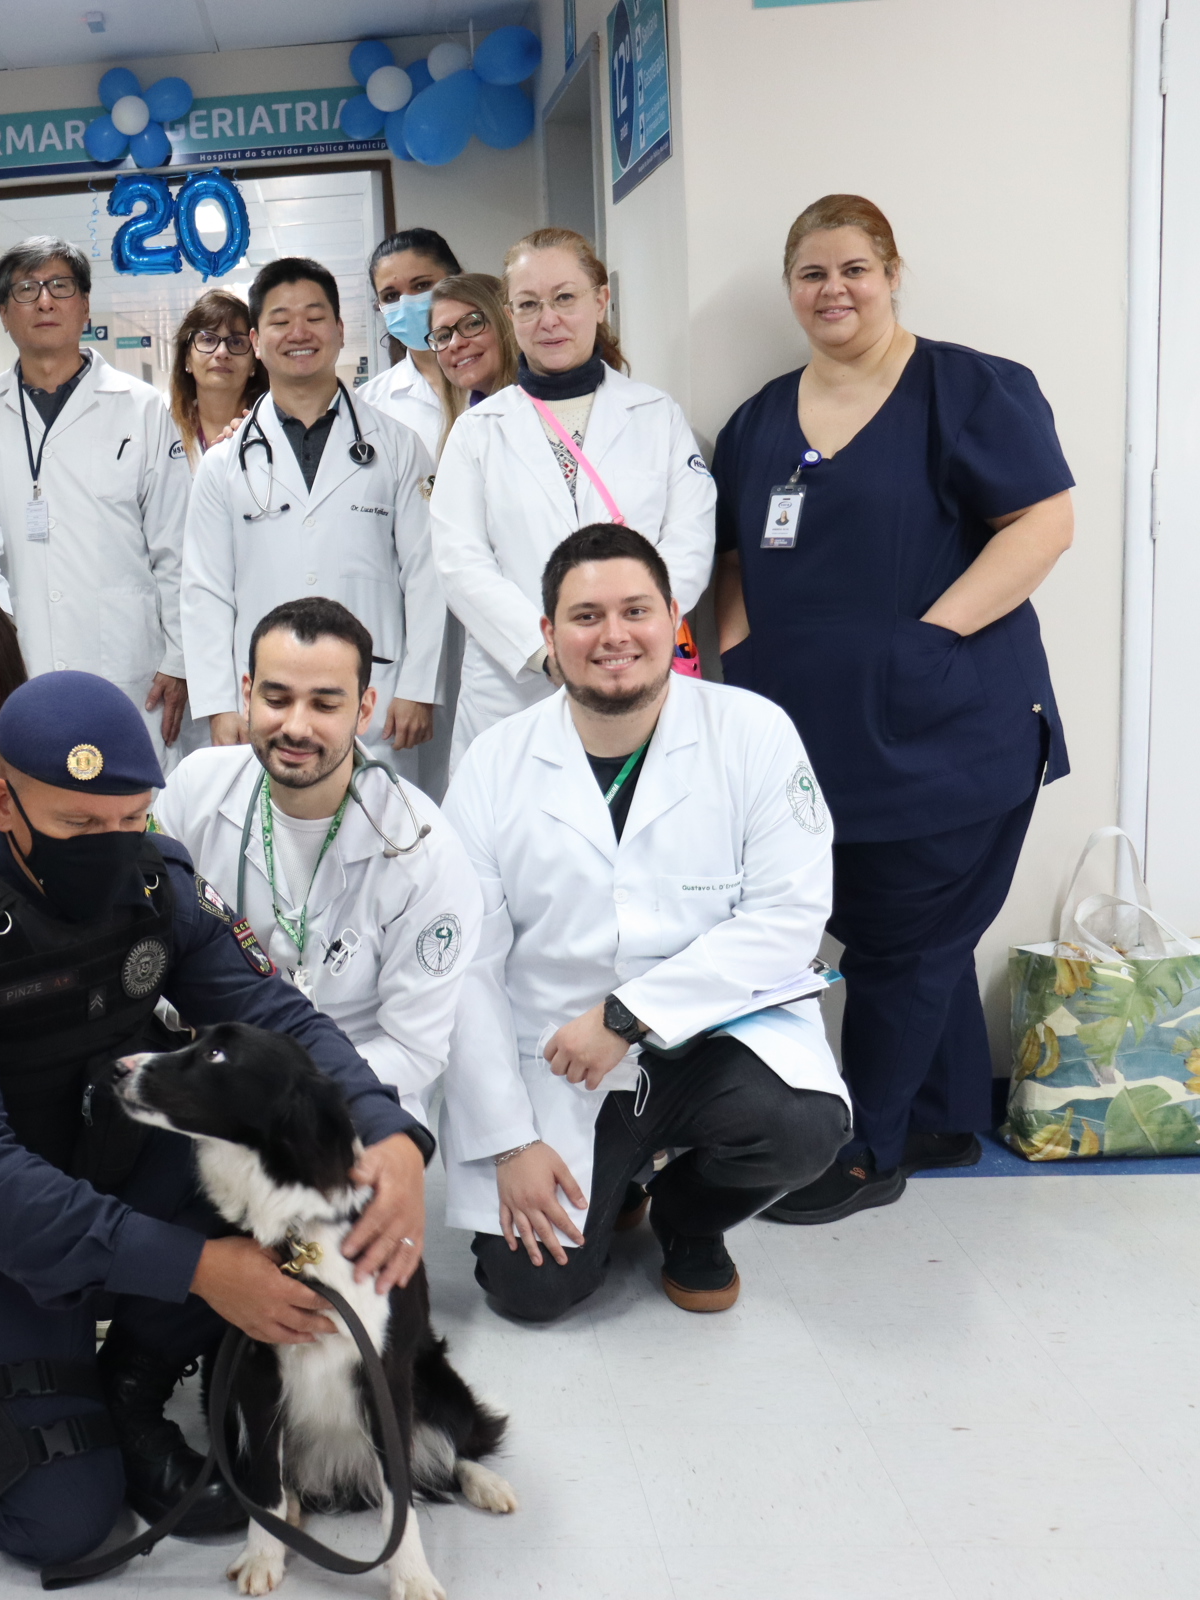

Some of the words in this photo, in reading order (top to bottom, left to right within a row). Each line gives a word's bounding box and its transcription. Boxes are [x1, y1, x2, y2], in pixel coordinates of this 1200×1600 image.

[200, 152, 241, 163] Hospital
[245, 149, 256, 158] do
[260, 147, 303, 157] Servidor
[307, 144, 344, 154] Público
[348, 140, 387, 151] Municip
[106, 168, 250, 280] 20
[605, 783, 620, 805] EDICINA
[681, 884, 711, 892] Gustavo
[241, 935, 257, 949] CANIL
[6, 982, 42, 1001] PINZE
